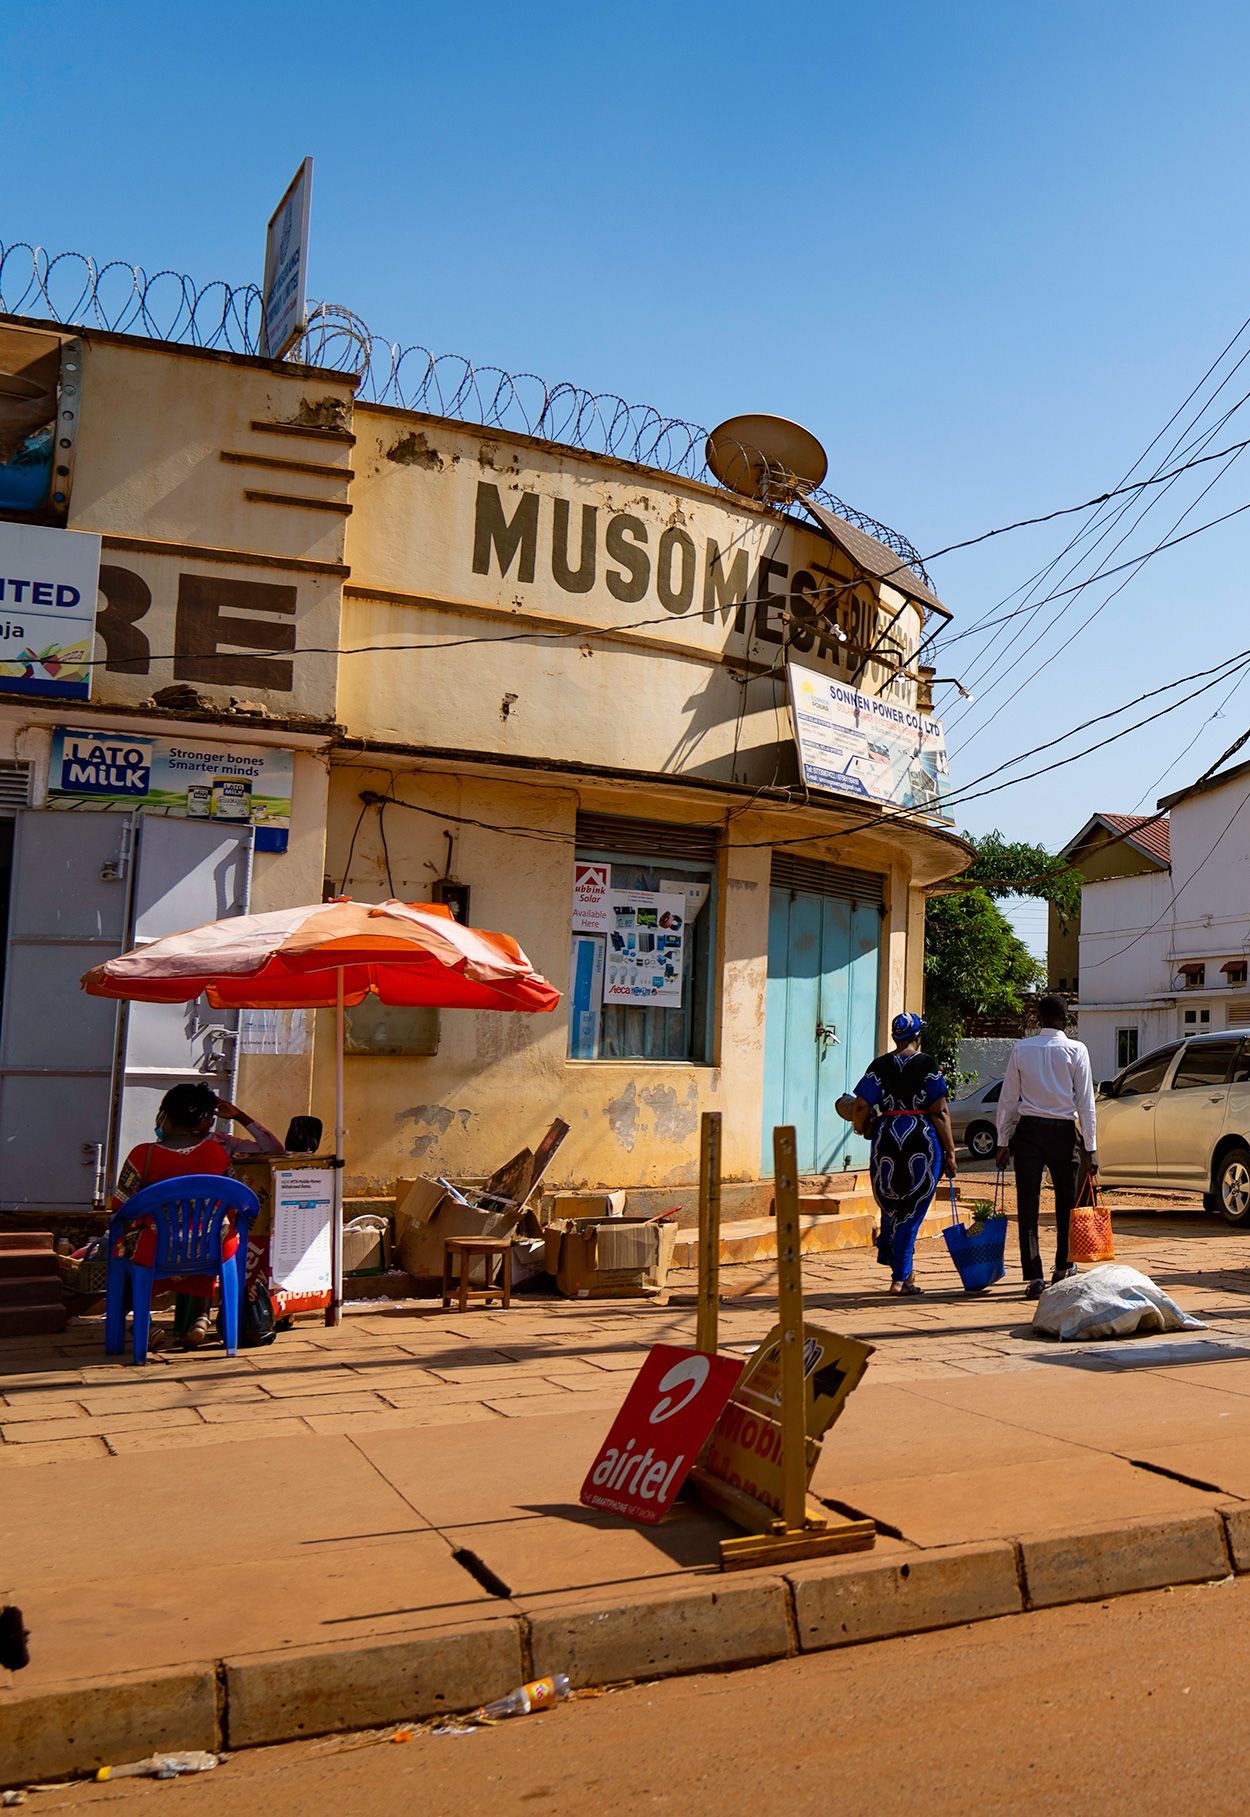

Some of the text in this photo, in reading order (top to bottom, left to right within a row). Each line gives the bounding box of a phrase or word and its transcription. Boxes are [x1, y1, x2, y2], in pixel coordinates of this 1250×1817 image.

[830, 686, 869, 711] SONNEN
[873, 702, 904, 725] POWER
[925, 721, 940, 736] LTD
[72, 742, 144, 767] LATO
[170, 748, 264, 766] Stronger bones
[169, 759, 259, 777] Smarter minds
[575, 885, 606, 895] ubbink
[579, 894, 601, 904] Solar
[573, 908, 607, 920] Available
[581, 919, 600, 928] Here
[592, 1438, 685, 1503] airtel
